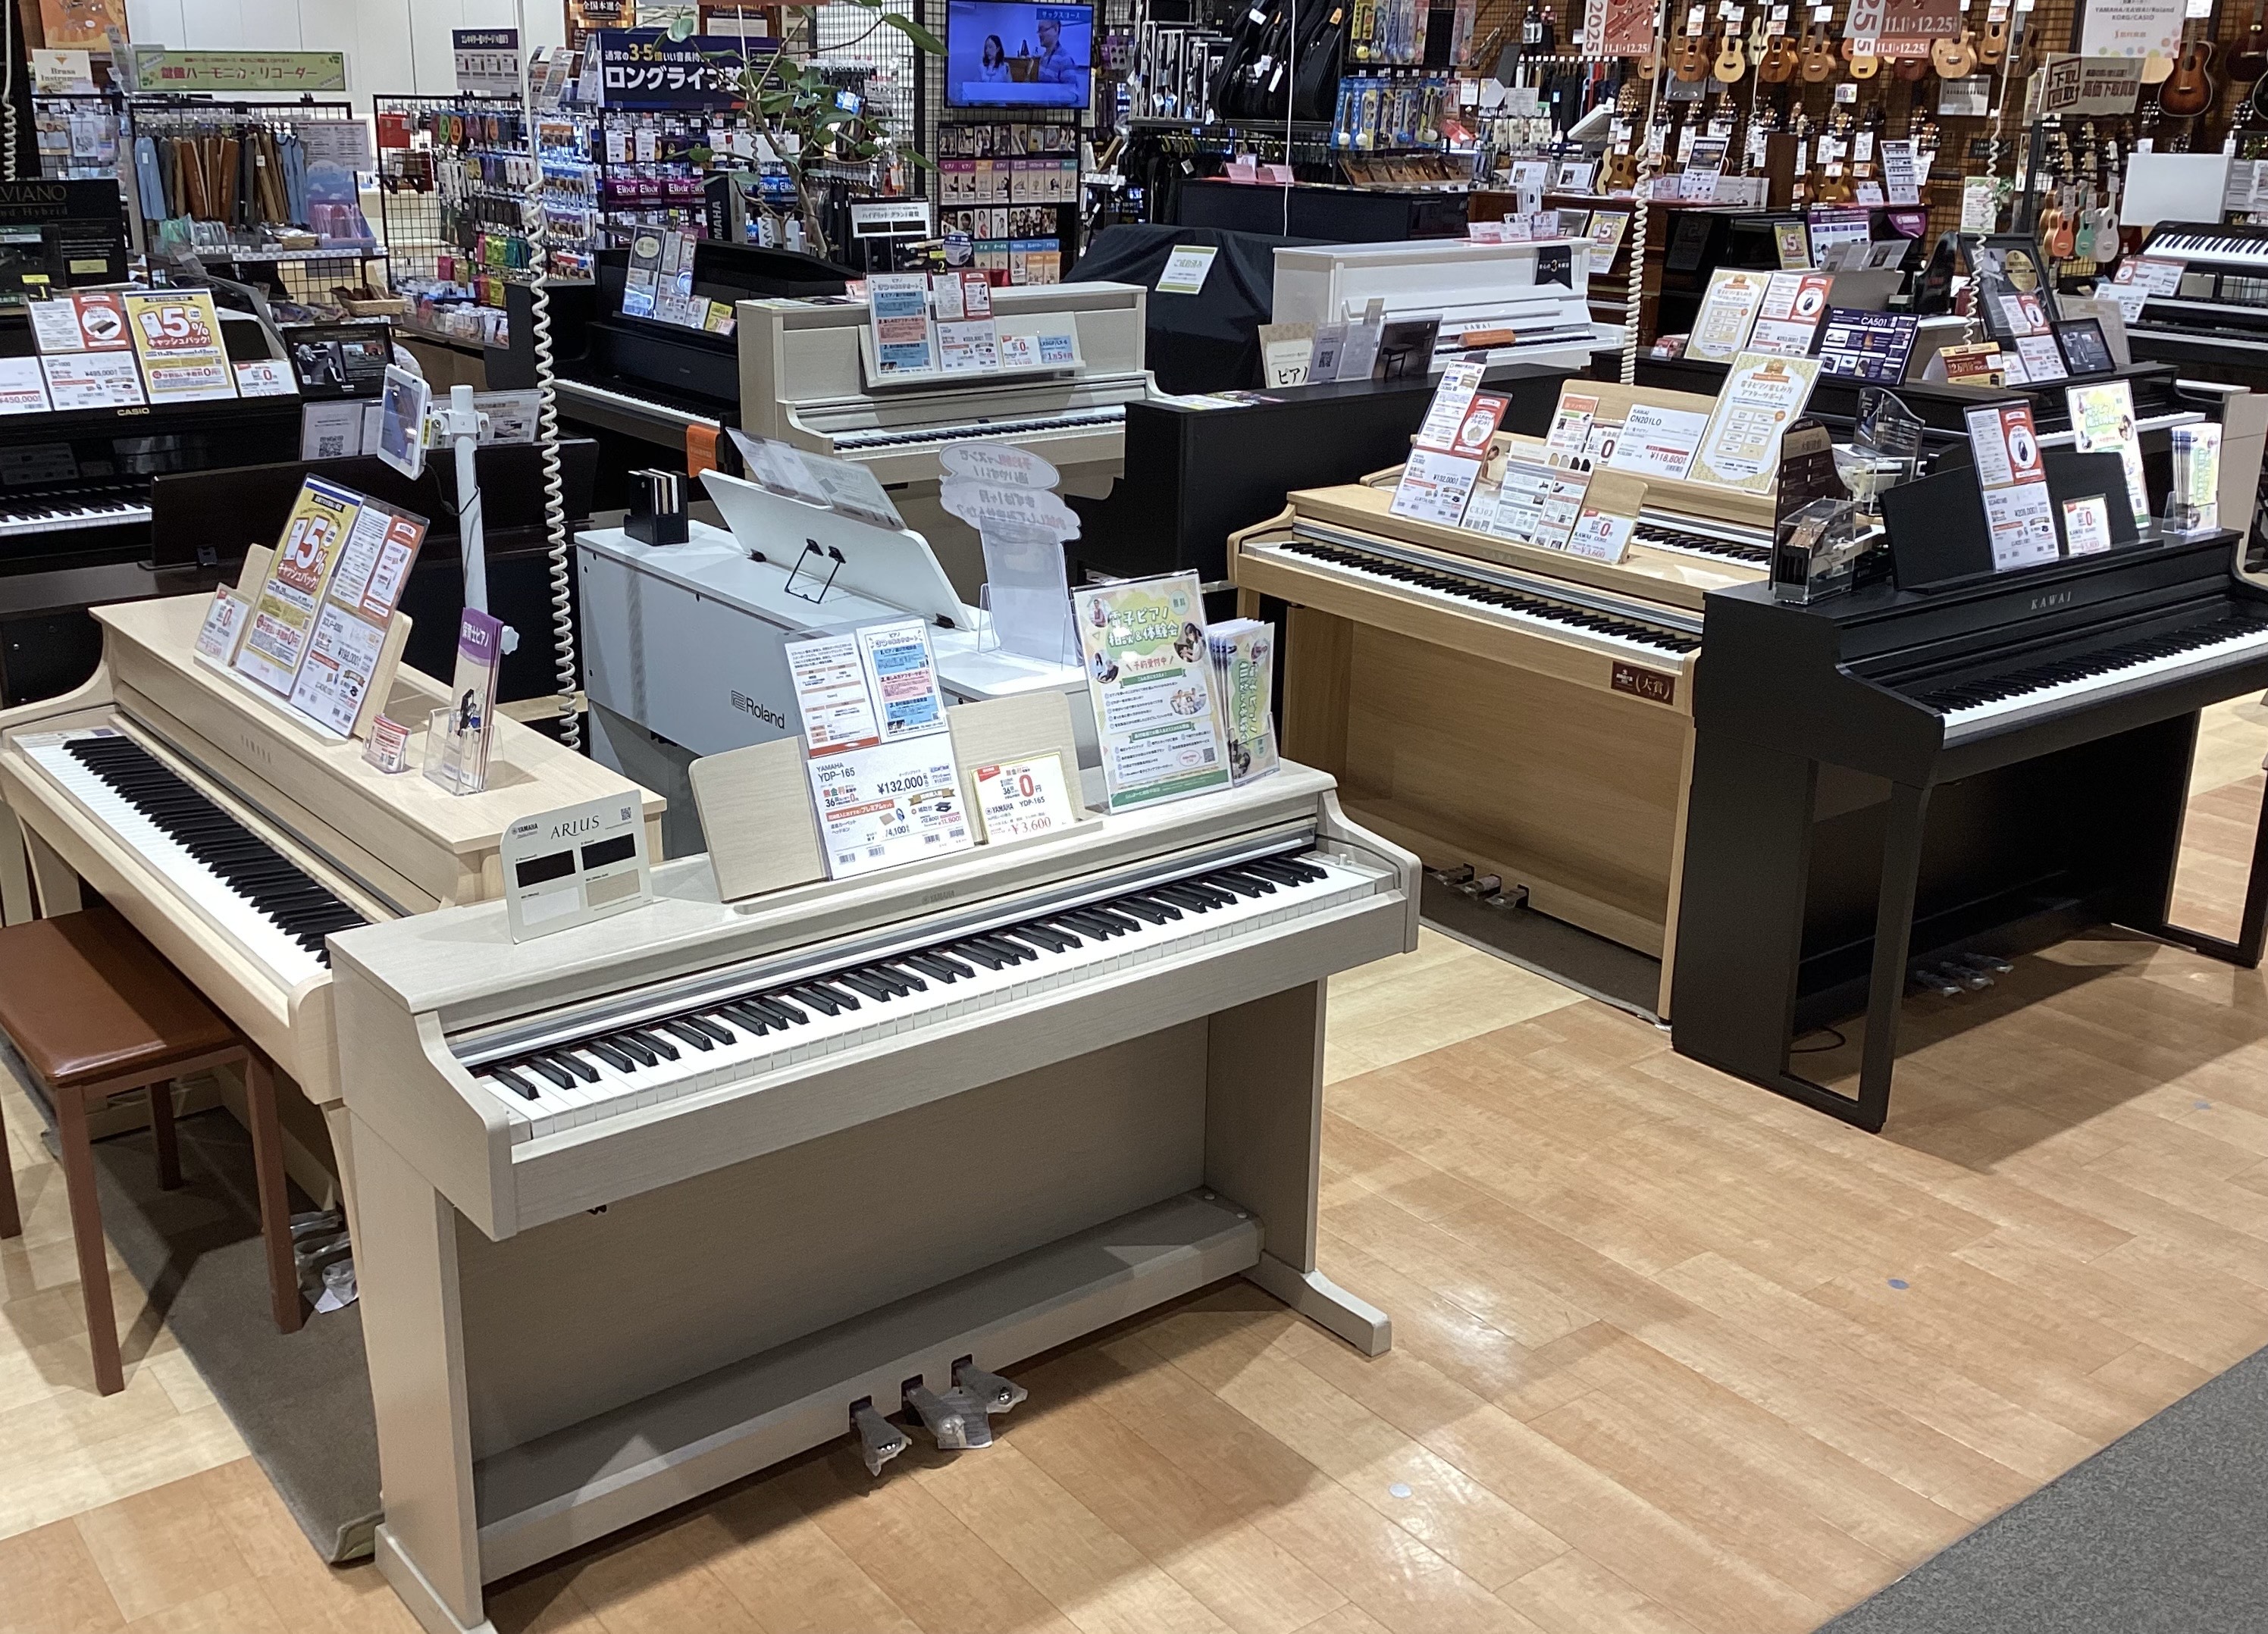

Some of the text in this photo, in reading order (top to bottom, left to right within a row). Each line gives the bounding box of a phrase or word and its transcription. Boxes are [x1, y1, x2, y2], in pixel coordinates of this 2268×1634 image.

[616, 184, 636, 193] Elixir
[640, 184, 659, 193] Elixir
[669, 183, 688, 193] Elixir
[1861, 316, 1887, 327] CA501
[1278, 366, 1308, 385] ピアノ
[117, 407, 150, 417] CASIO
[1631, 415, 1662, 426] CN201LO
[1470, 506, 1493, 517] CX302
[2031, 591, 2072, 608] KAWAI
[1108, 606, 1168, 628] 電子ピアノ
[746, 696, 785, 729] Roland
[816, 762, 844, 772] YAMAHA
[818, 767, 855, 783] YDP-165
[877, 775, 924, 795] ¥132,000
[1019, 774, 1034, 797] 0
[992, 796, 1045, 814] YAMAHA YDP-165
[518, 822, 539, 834] YAMAHA
[550, 814, 600, 840] ARIUS
[1011, 816, 1052, 835] ¥3,600
